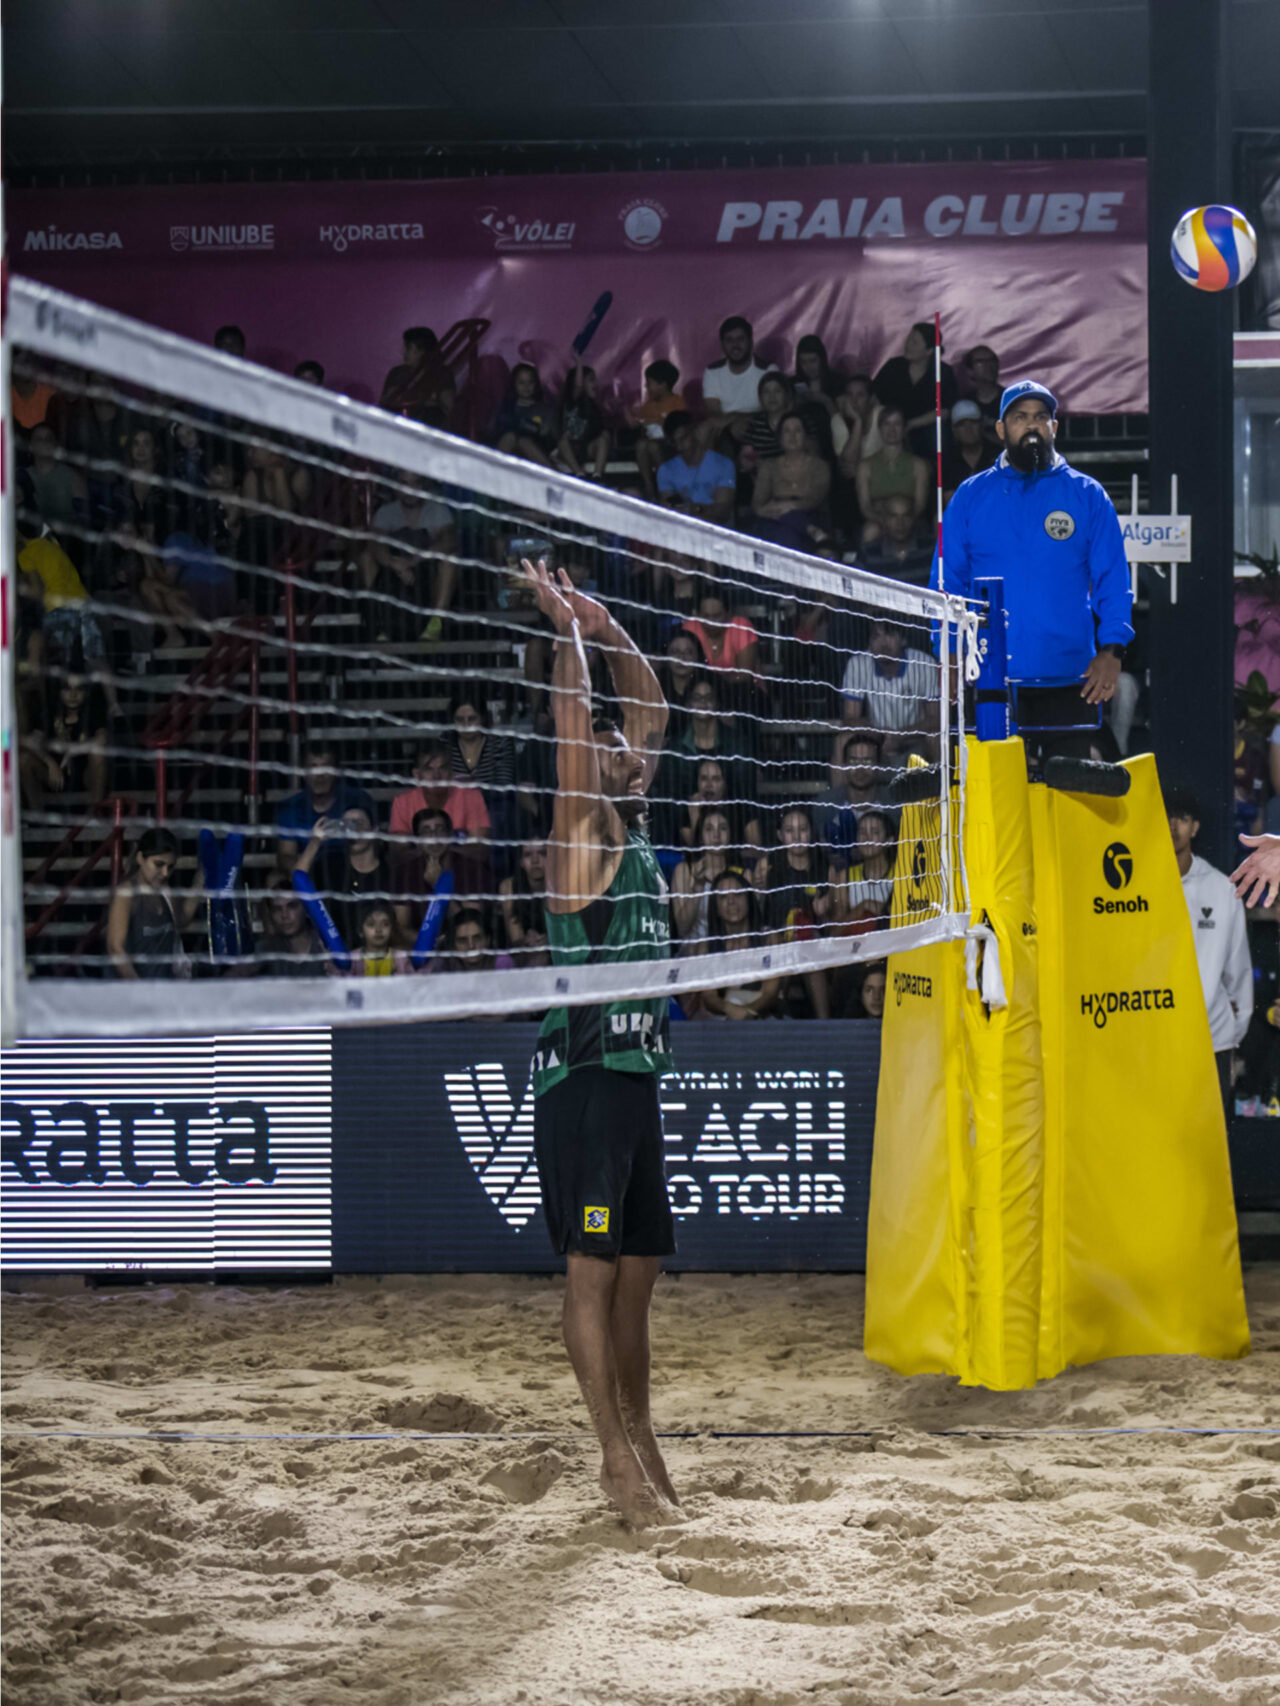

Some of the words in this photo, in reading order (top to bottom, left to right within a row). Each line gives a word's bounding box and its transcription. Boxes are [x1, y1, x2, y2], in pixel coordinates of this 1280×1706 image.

[716, 198, 906, 243] PRAIA
[924, 192, 1126, 237] CLUBE
[192, 225, 274, 245] UNIUBE
[514, 219, 576, 241] VÔLEI
[1123, 522, 1172, 545] Algar
[1093, 895, 1149, 914] Senoh
[660, 1102, 845, 1162] EACH
[709, 1173, 845, 1220] TOUR
